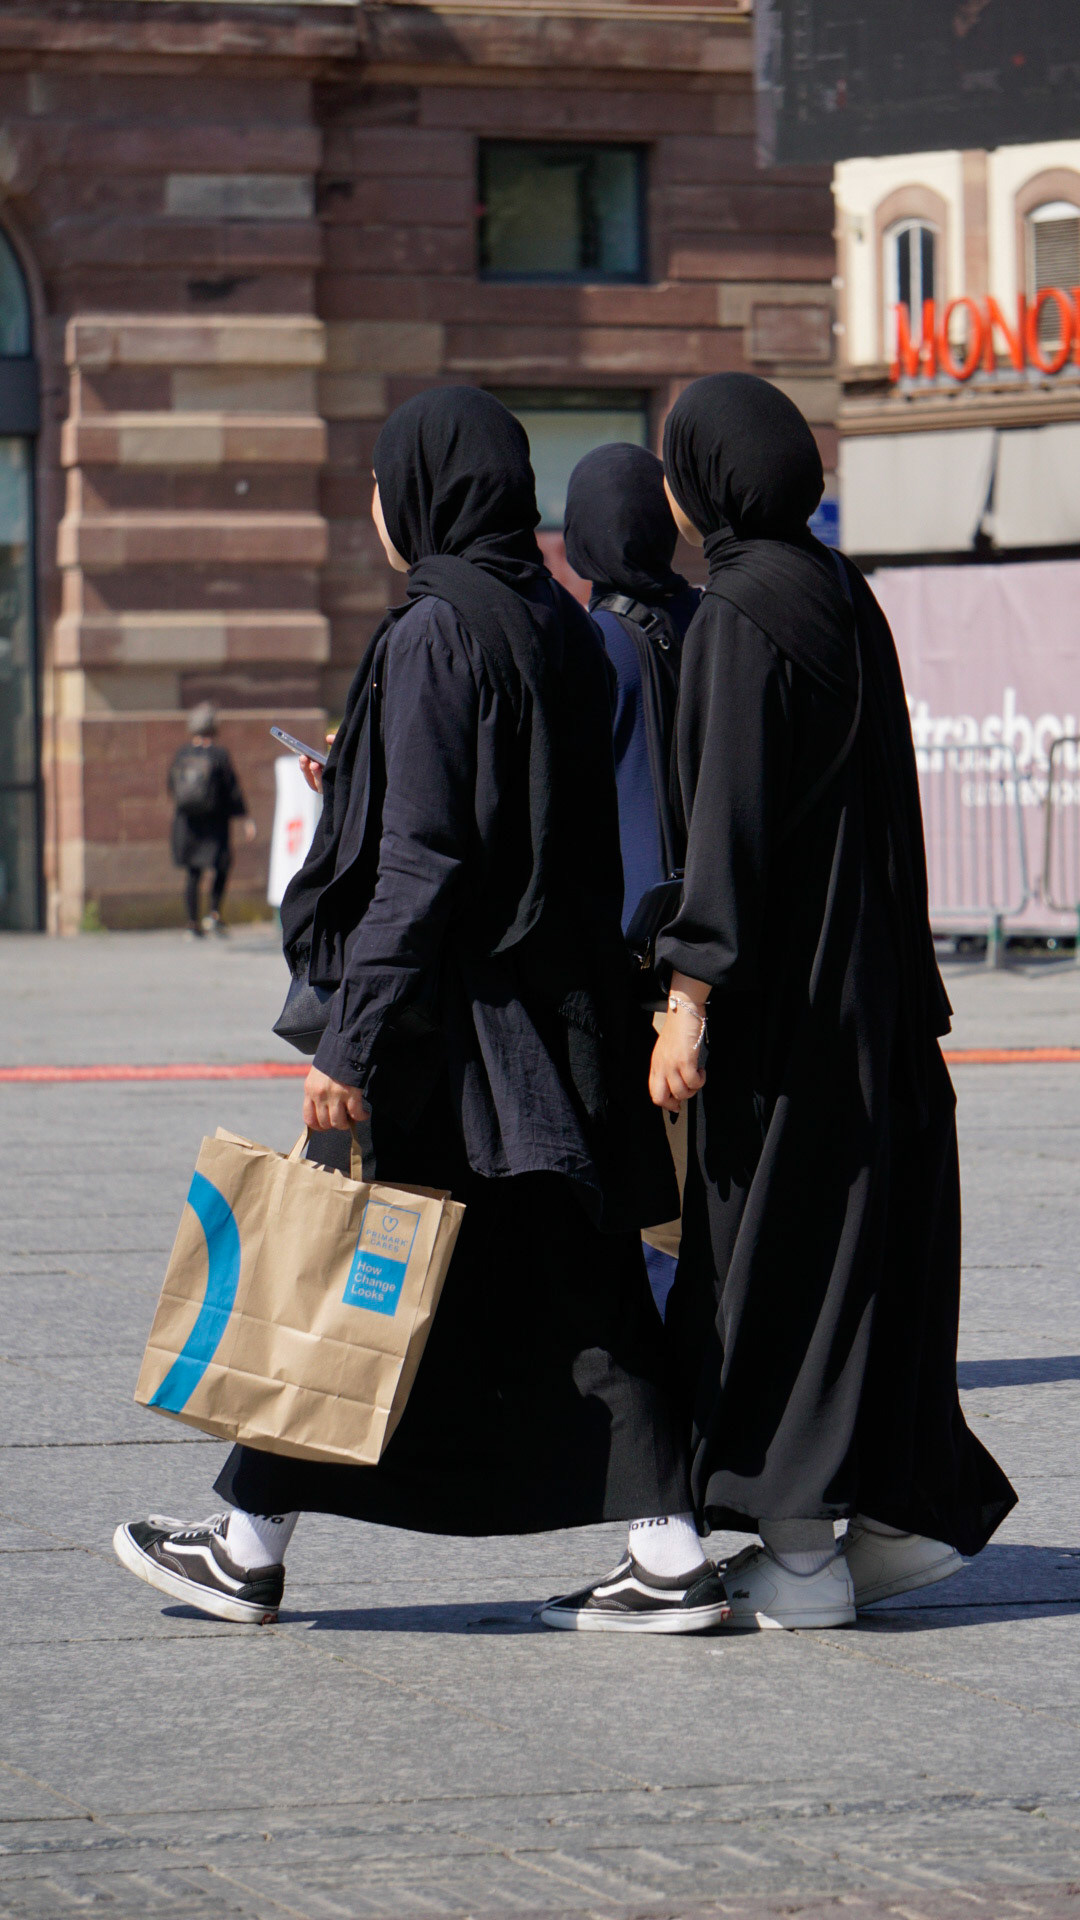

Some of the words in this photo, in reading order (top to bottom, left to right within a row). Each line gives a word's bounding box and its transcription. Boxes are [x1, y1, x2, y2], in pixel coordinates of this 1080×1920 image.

[905, 685, 1080, 773] trasbou
[366, 1229, 407, 1247] PRIMARK
[371, 1239, 399, 1252] CARES
[357, 1261, 382, 1275] How
[354, 1273, 396, 1292] Change
[351, 1284, 384, 1302] Looks
